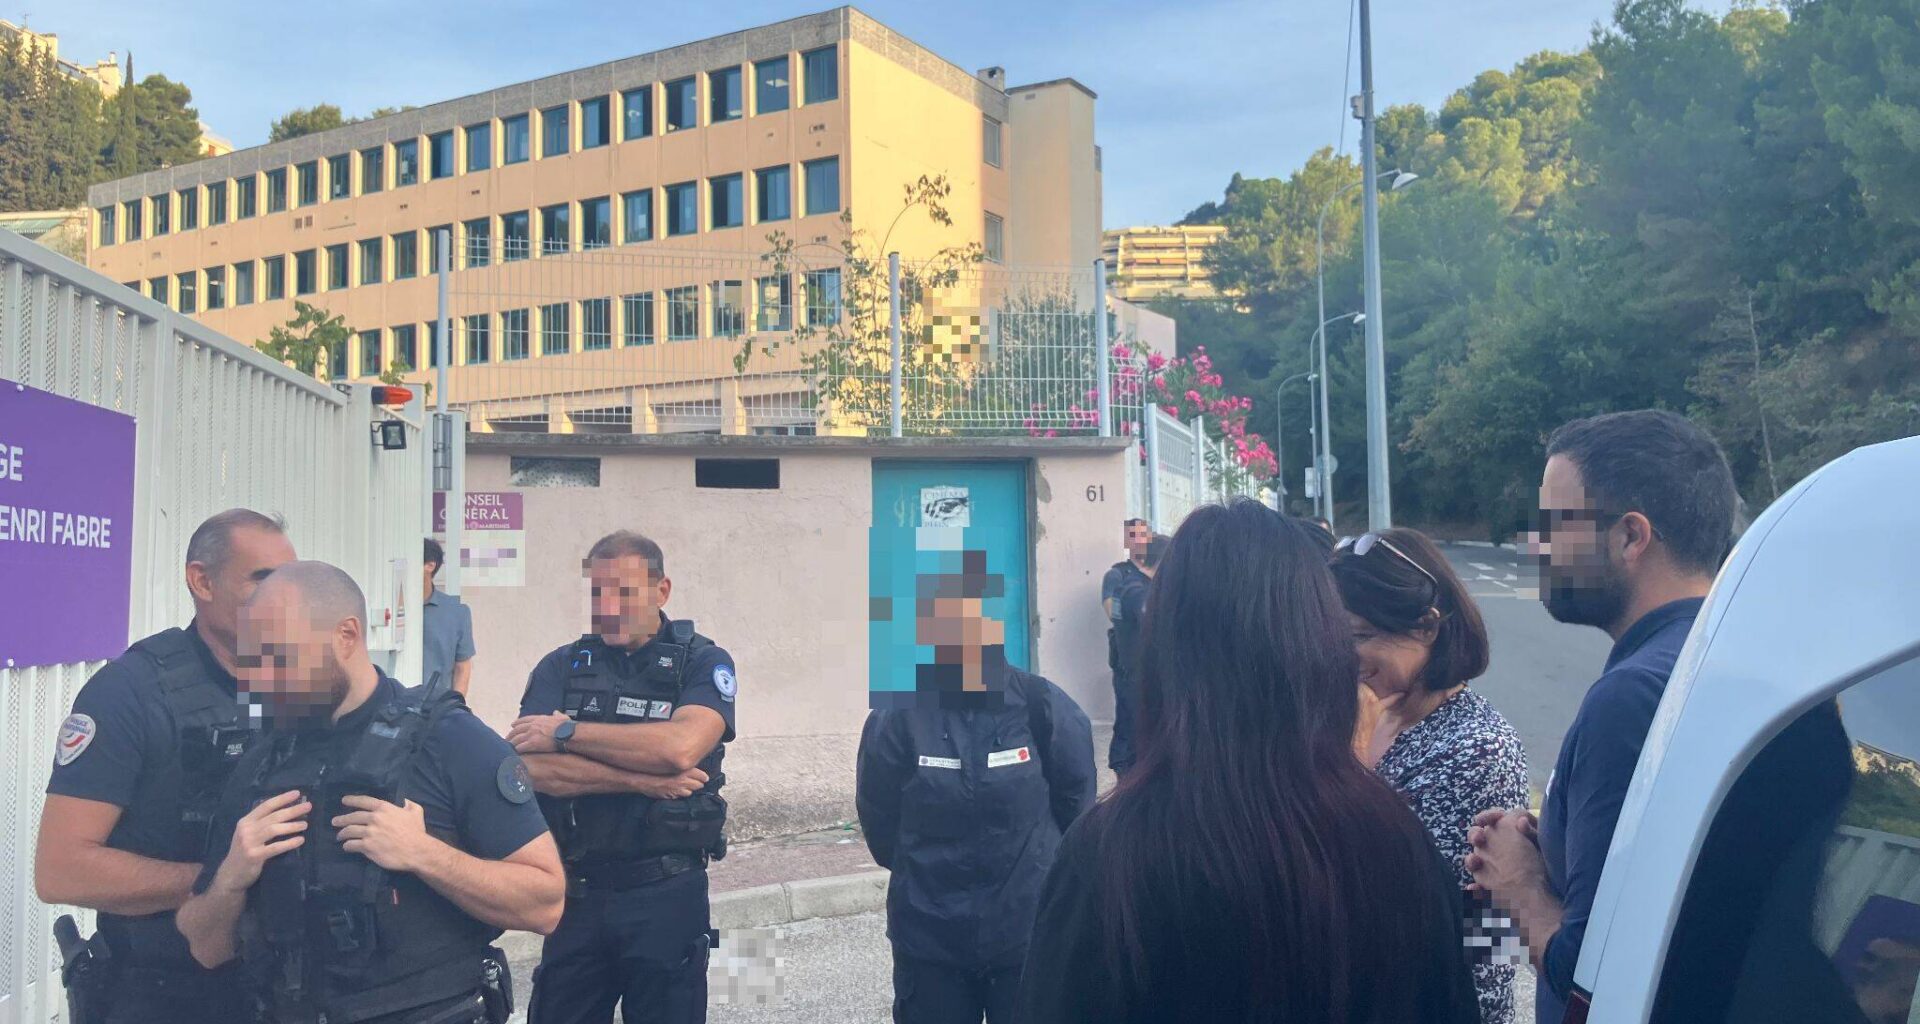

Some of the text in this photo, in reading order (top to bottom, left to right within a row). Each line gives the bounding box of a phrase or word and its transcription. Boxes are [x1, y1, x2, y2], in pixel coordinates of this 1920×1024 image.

[465, 494, 503, 506] NSEIL
[1086, 485, 1104, 502] 61
[52, 512, 111, 548] FABRE
